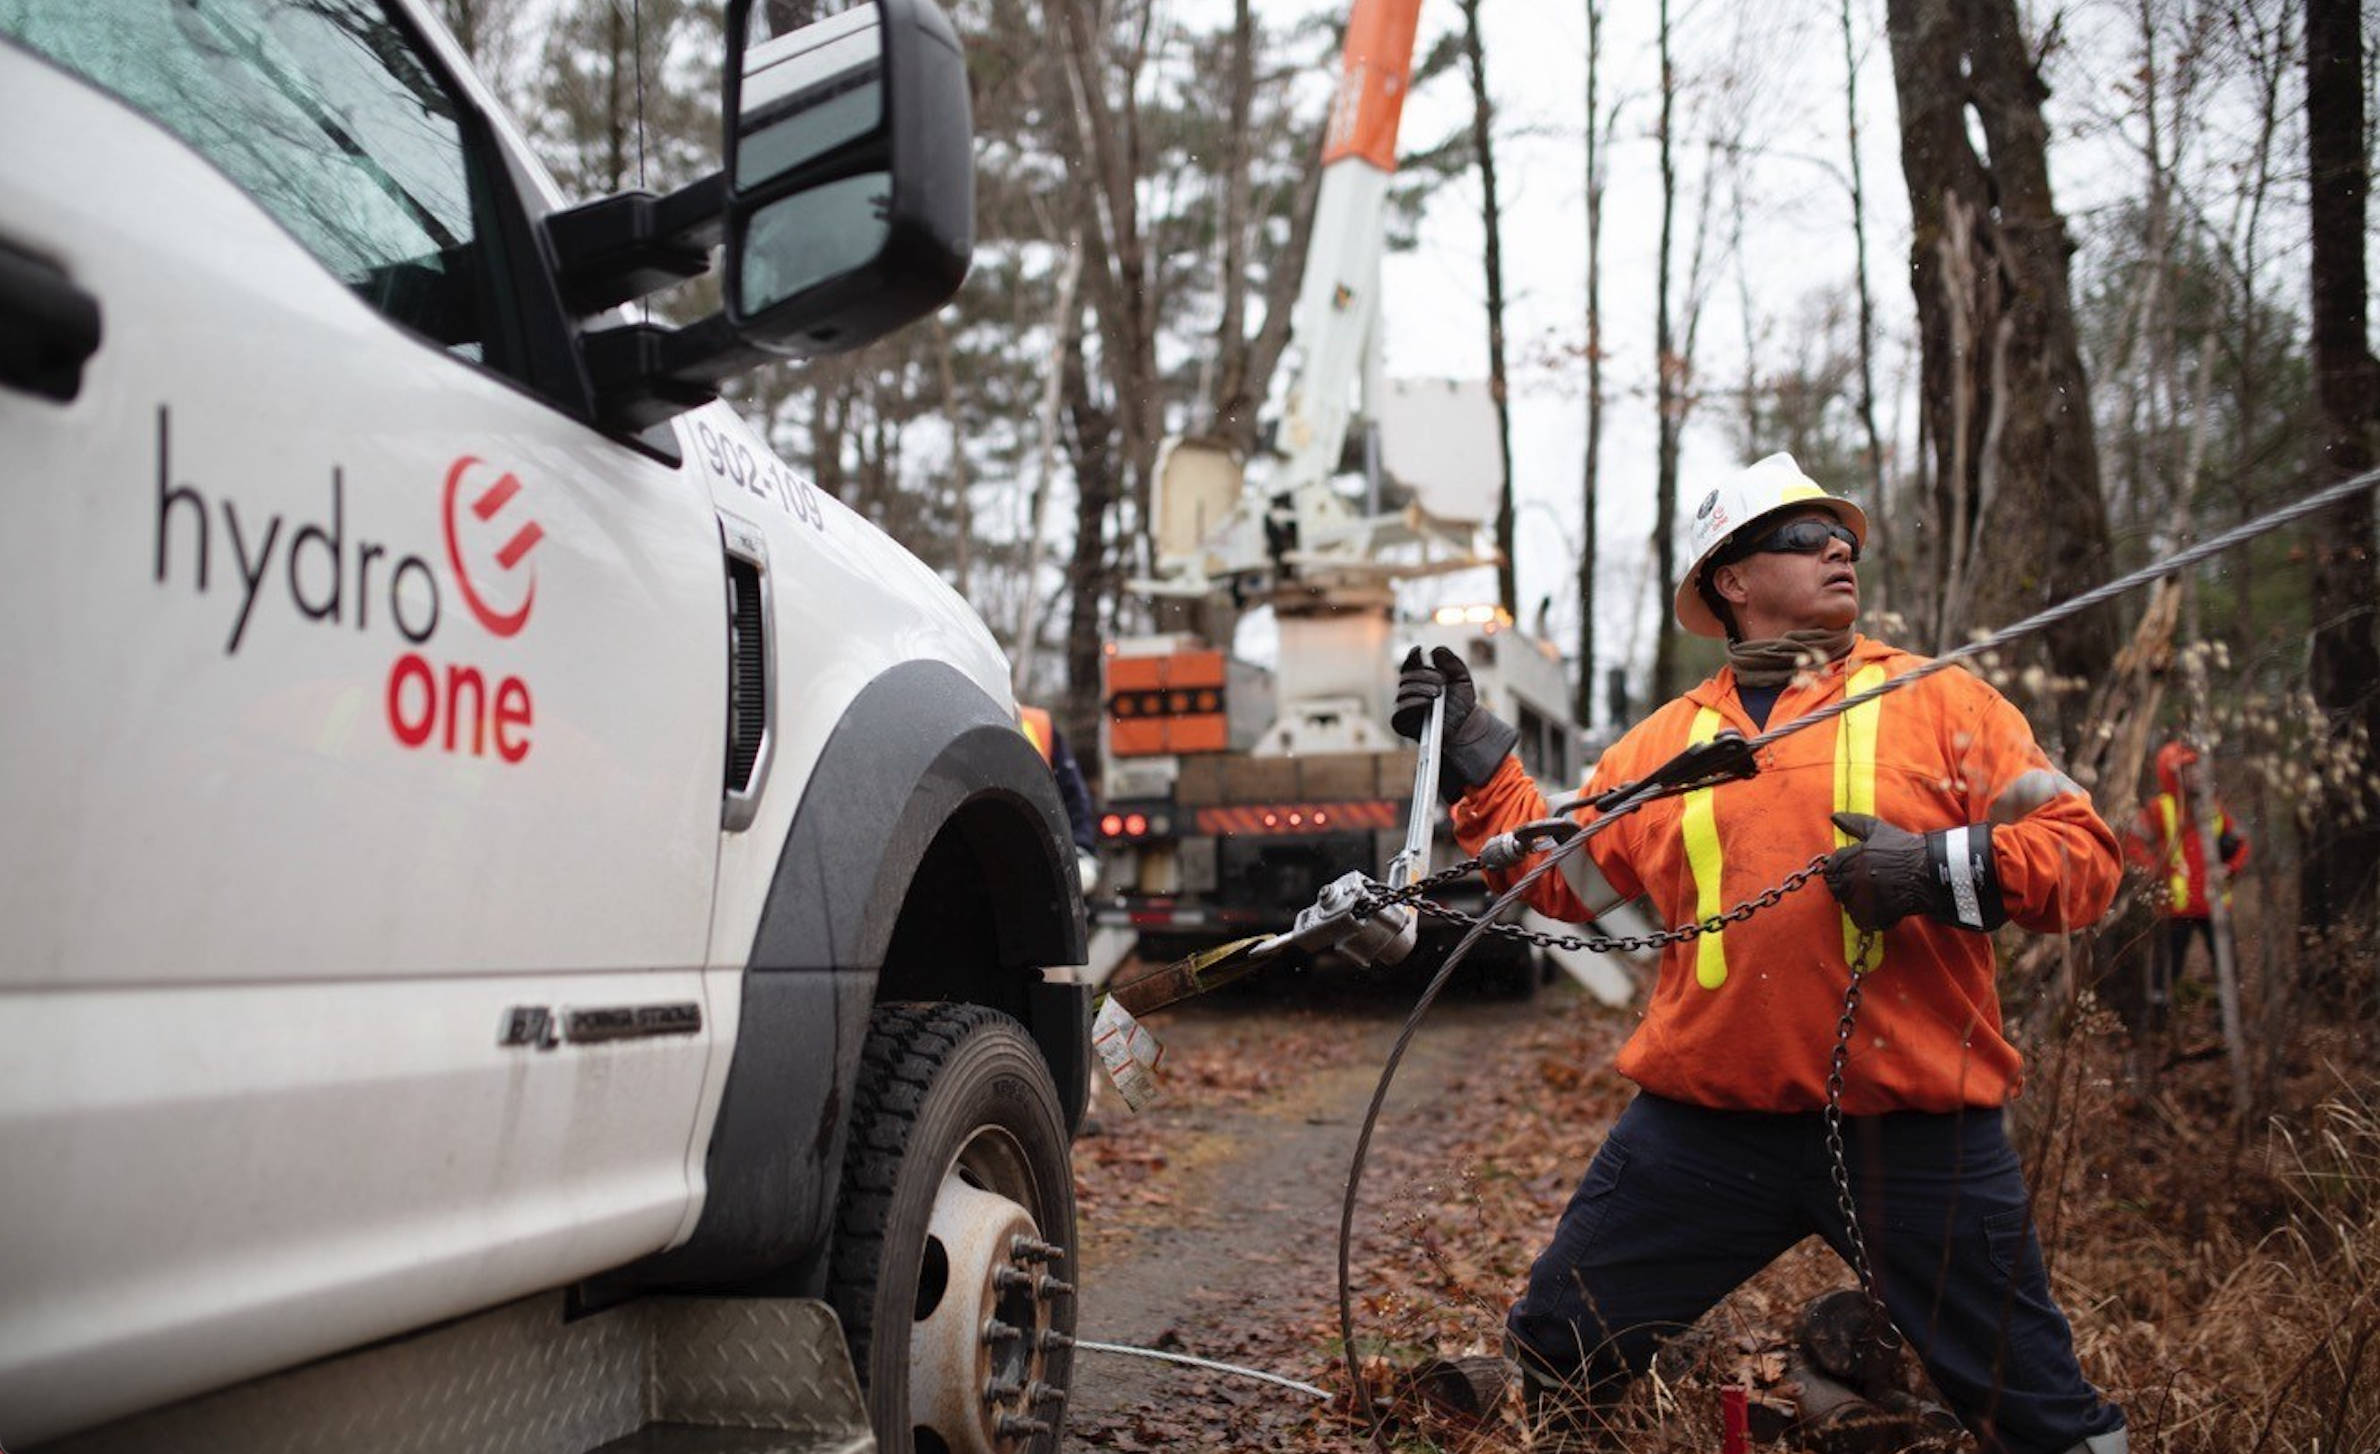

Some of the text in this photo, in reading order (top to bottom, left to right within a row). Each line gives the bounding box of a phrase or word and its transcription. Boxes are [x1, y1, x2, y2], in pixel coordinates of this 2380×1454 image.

[155, 403, 440, 657] hydro
[697, 420, 824, 532] 902-109
[386, 652, 534, 766] one
